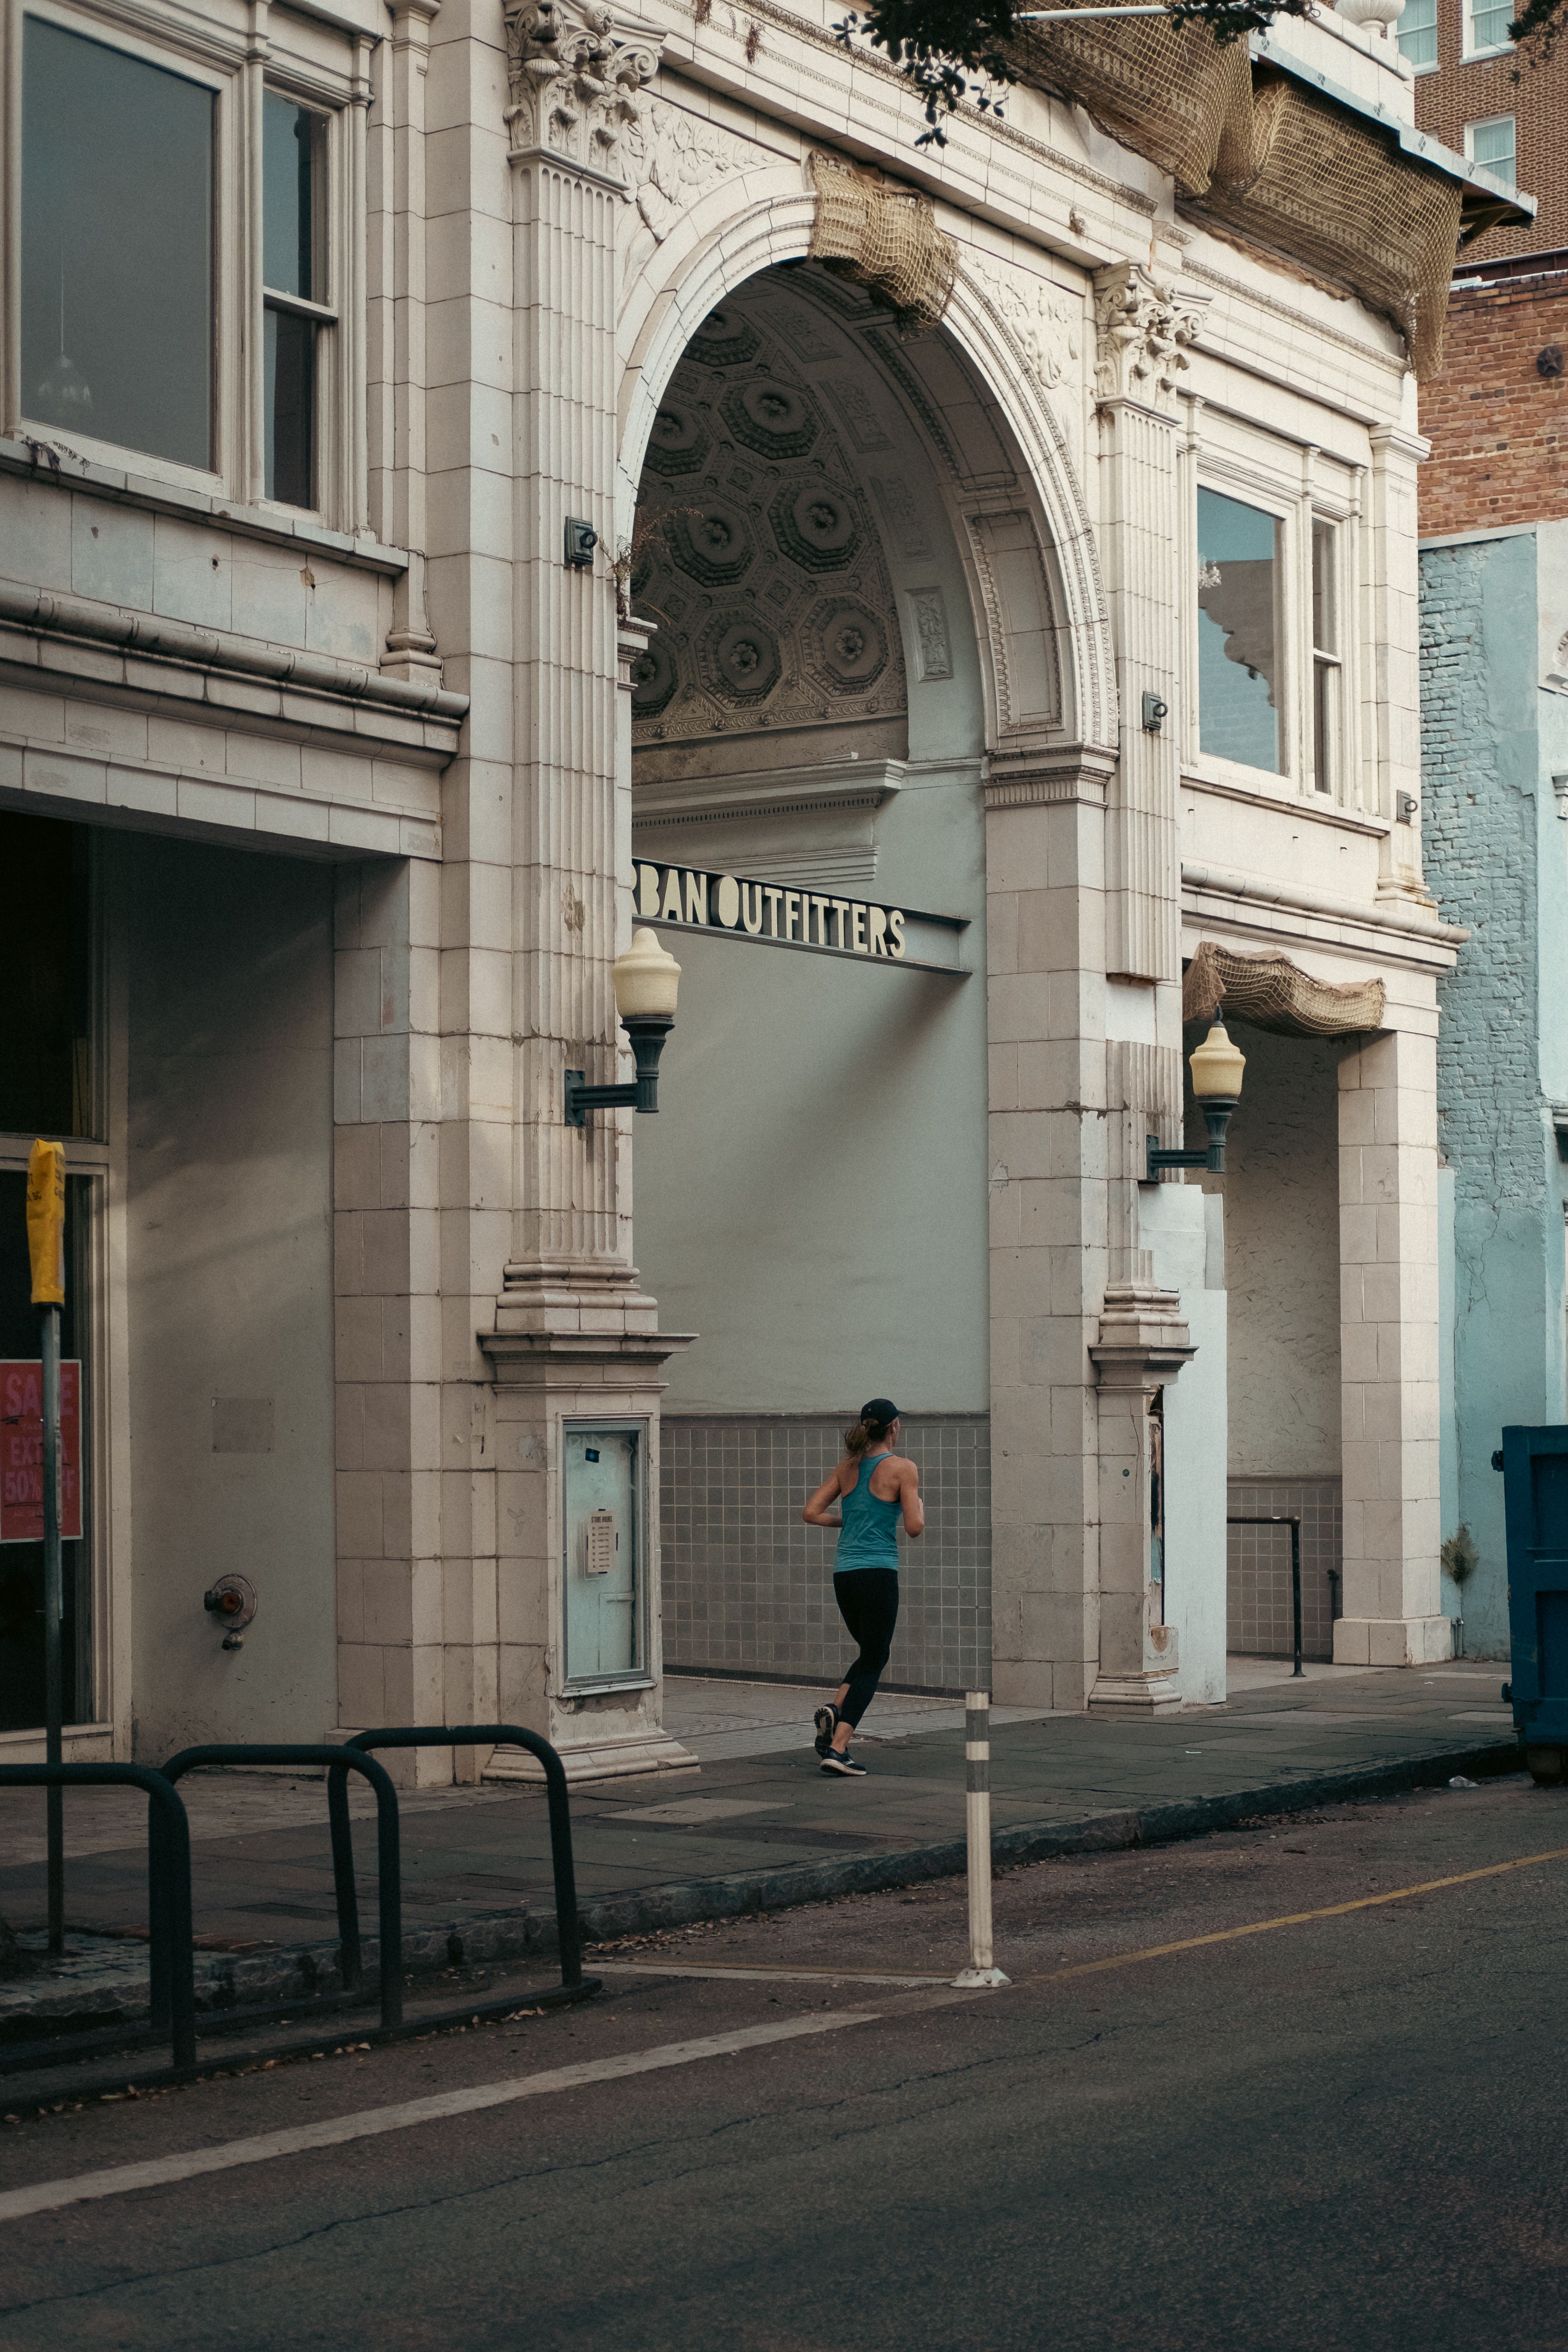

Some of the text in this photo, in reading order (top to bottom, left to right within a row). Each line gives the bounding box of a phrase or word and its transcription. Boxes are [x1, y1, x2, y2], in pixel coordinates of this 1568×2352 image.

[718, 875, 906, 957] OUTFITTERS
[6, 1373, 73, 1416] SAE
[11, 1437, 68, 1465] EXT
[5, 1470, 41, 1501] 50%
